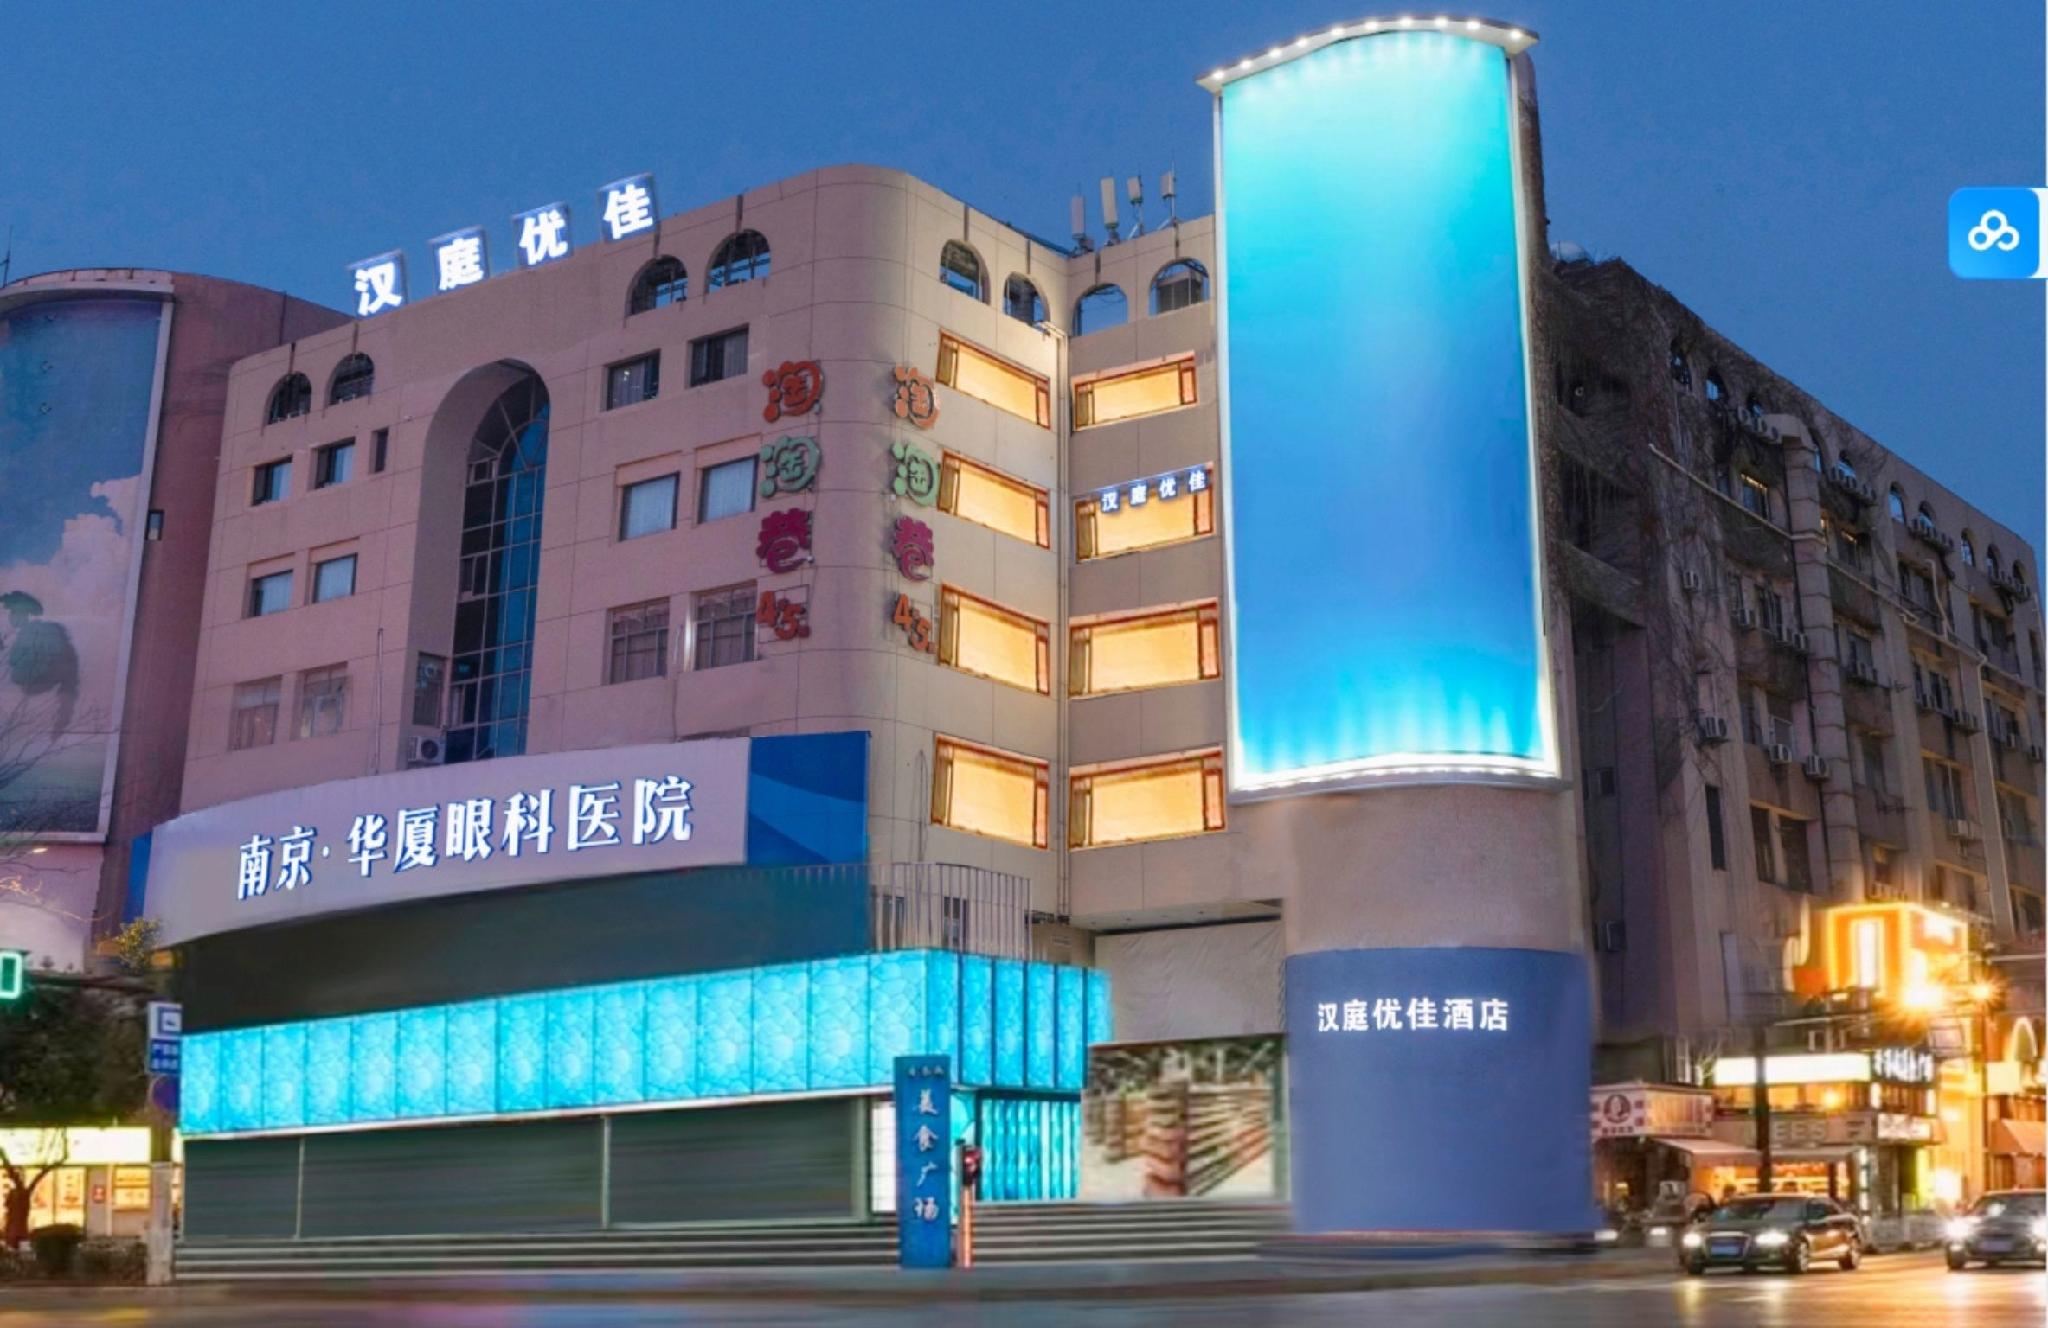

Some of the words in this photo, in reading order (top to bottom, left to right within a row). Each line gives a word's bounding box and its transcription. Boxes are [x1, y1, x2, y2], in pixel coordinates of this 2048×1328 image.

[354, 183, 653, 316] 汉庭优佳
[1101, 469, 1205, 512] 汉庭优佳
[1317, 997, 1509, 1032] 汉庭优佳酒店
[913, 1088, 938, 1221] 美食广场
